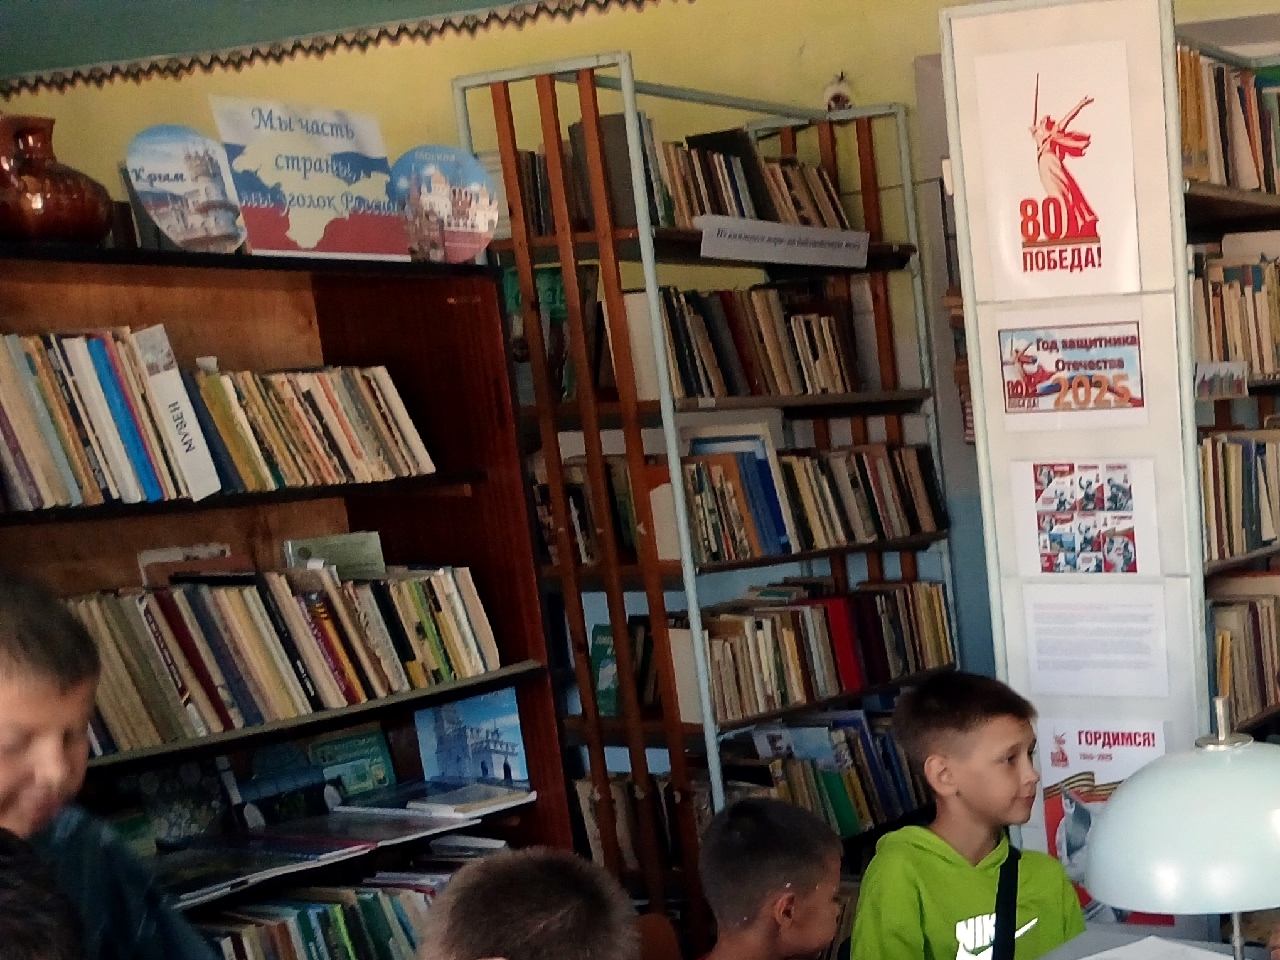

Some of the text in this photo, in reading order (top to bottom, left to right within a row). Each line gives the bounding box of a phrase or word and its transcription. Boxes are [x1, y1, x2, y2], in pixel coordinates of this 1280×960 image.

[251, 106, 355, 140] Мы часть
[1020, 198, 1063, 242] 80
[1022, 247, 1102, 273] ПОБЕДА!
[1036, 335, 1138, 353] Год защитника
[1055, 358, 1124, 372] Отечества
[1053, 375, 1131, 410] 2025
[1077, 730, 1156, 749] ГОРДИМСЯ!
[955, 913, 996, 952] NIK
